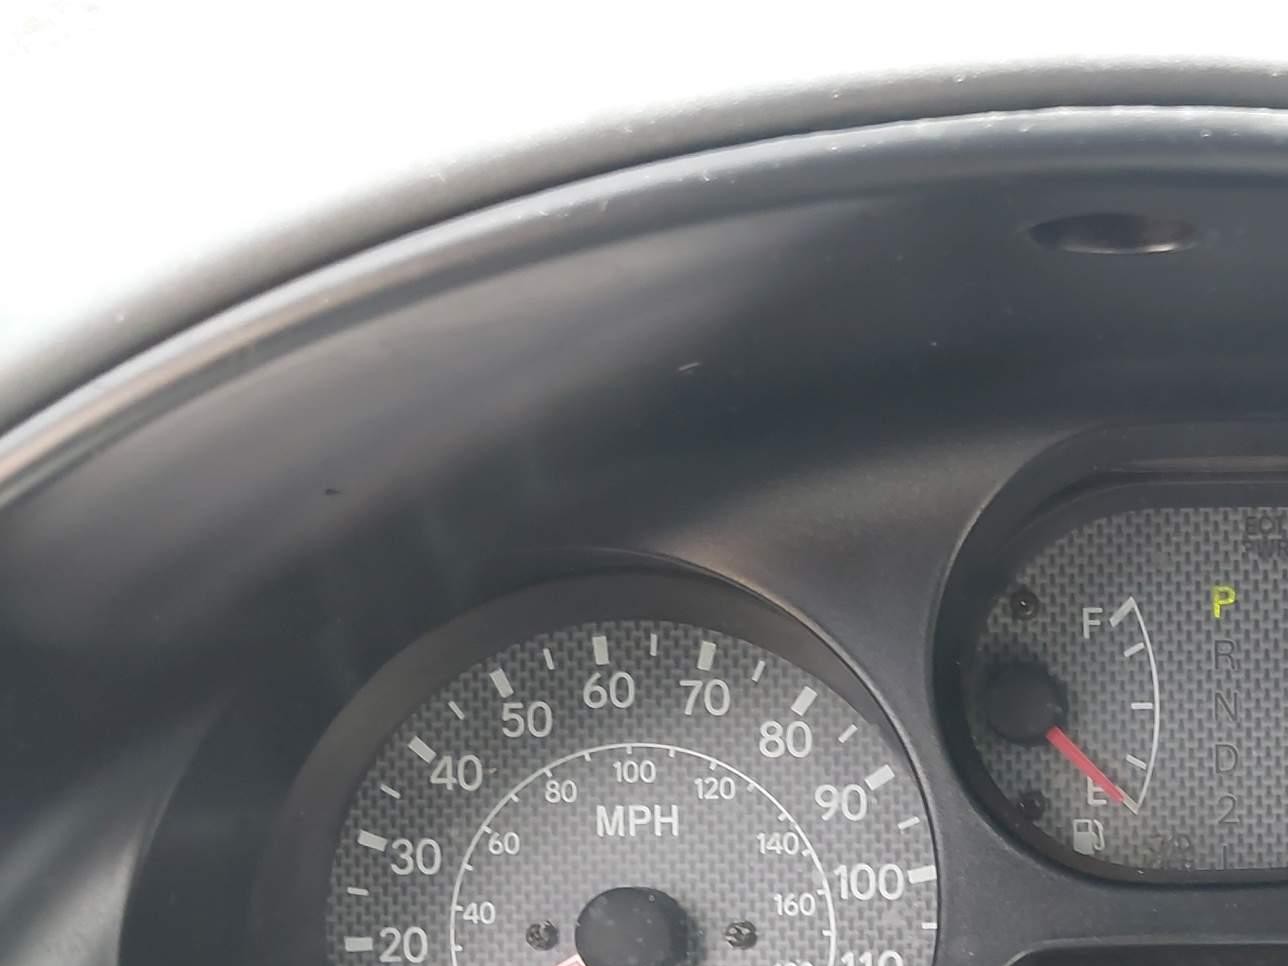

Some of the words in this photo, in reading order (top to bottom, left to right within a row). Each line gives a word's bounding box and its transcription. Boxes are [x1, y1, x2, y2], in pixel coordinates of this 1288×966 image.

[1213, 585, 1236, 618] P
[1083, 607, 1103, 638] F
[1214, 640, 1237, 671] R
[583, 671, 635, 708] 60
[679, 679, 730, 716] 70
[1214, 690, 1239, 721] N
[501, 701, 553, 737] 50
[759, 720, 813, 758] 80
[430, 755, 483, 791] 40
[613, 760, 656, 783] 100
[1214, 743, 1239, 774] D
[544, 780, 577, 803] 80
[694, 776, 736, 800] 120
[814, 784, 867, 821] 90
[1086, 776, 1108, 806] E
[596, 804, 679, 837] MPH
[1217, 792, 1241, 825] 2
[390, 838, 442, 875] 30
[488, 831, 520, 855] 60
[757, 832, 799, 856] 140
[834, 863, 905, 901] 100
[463, 901, 496, 924] 40
[774, 893, 816, 917] 160
[379, 926, 428, 963] 20
